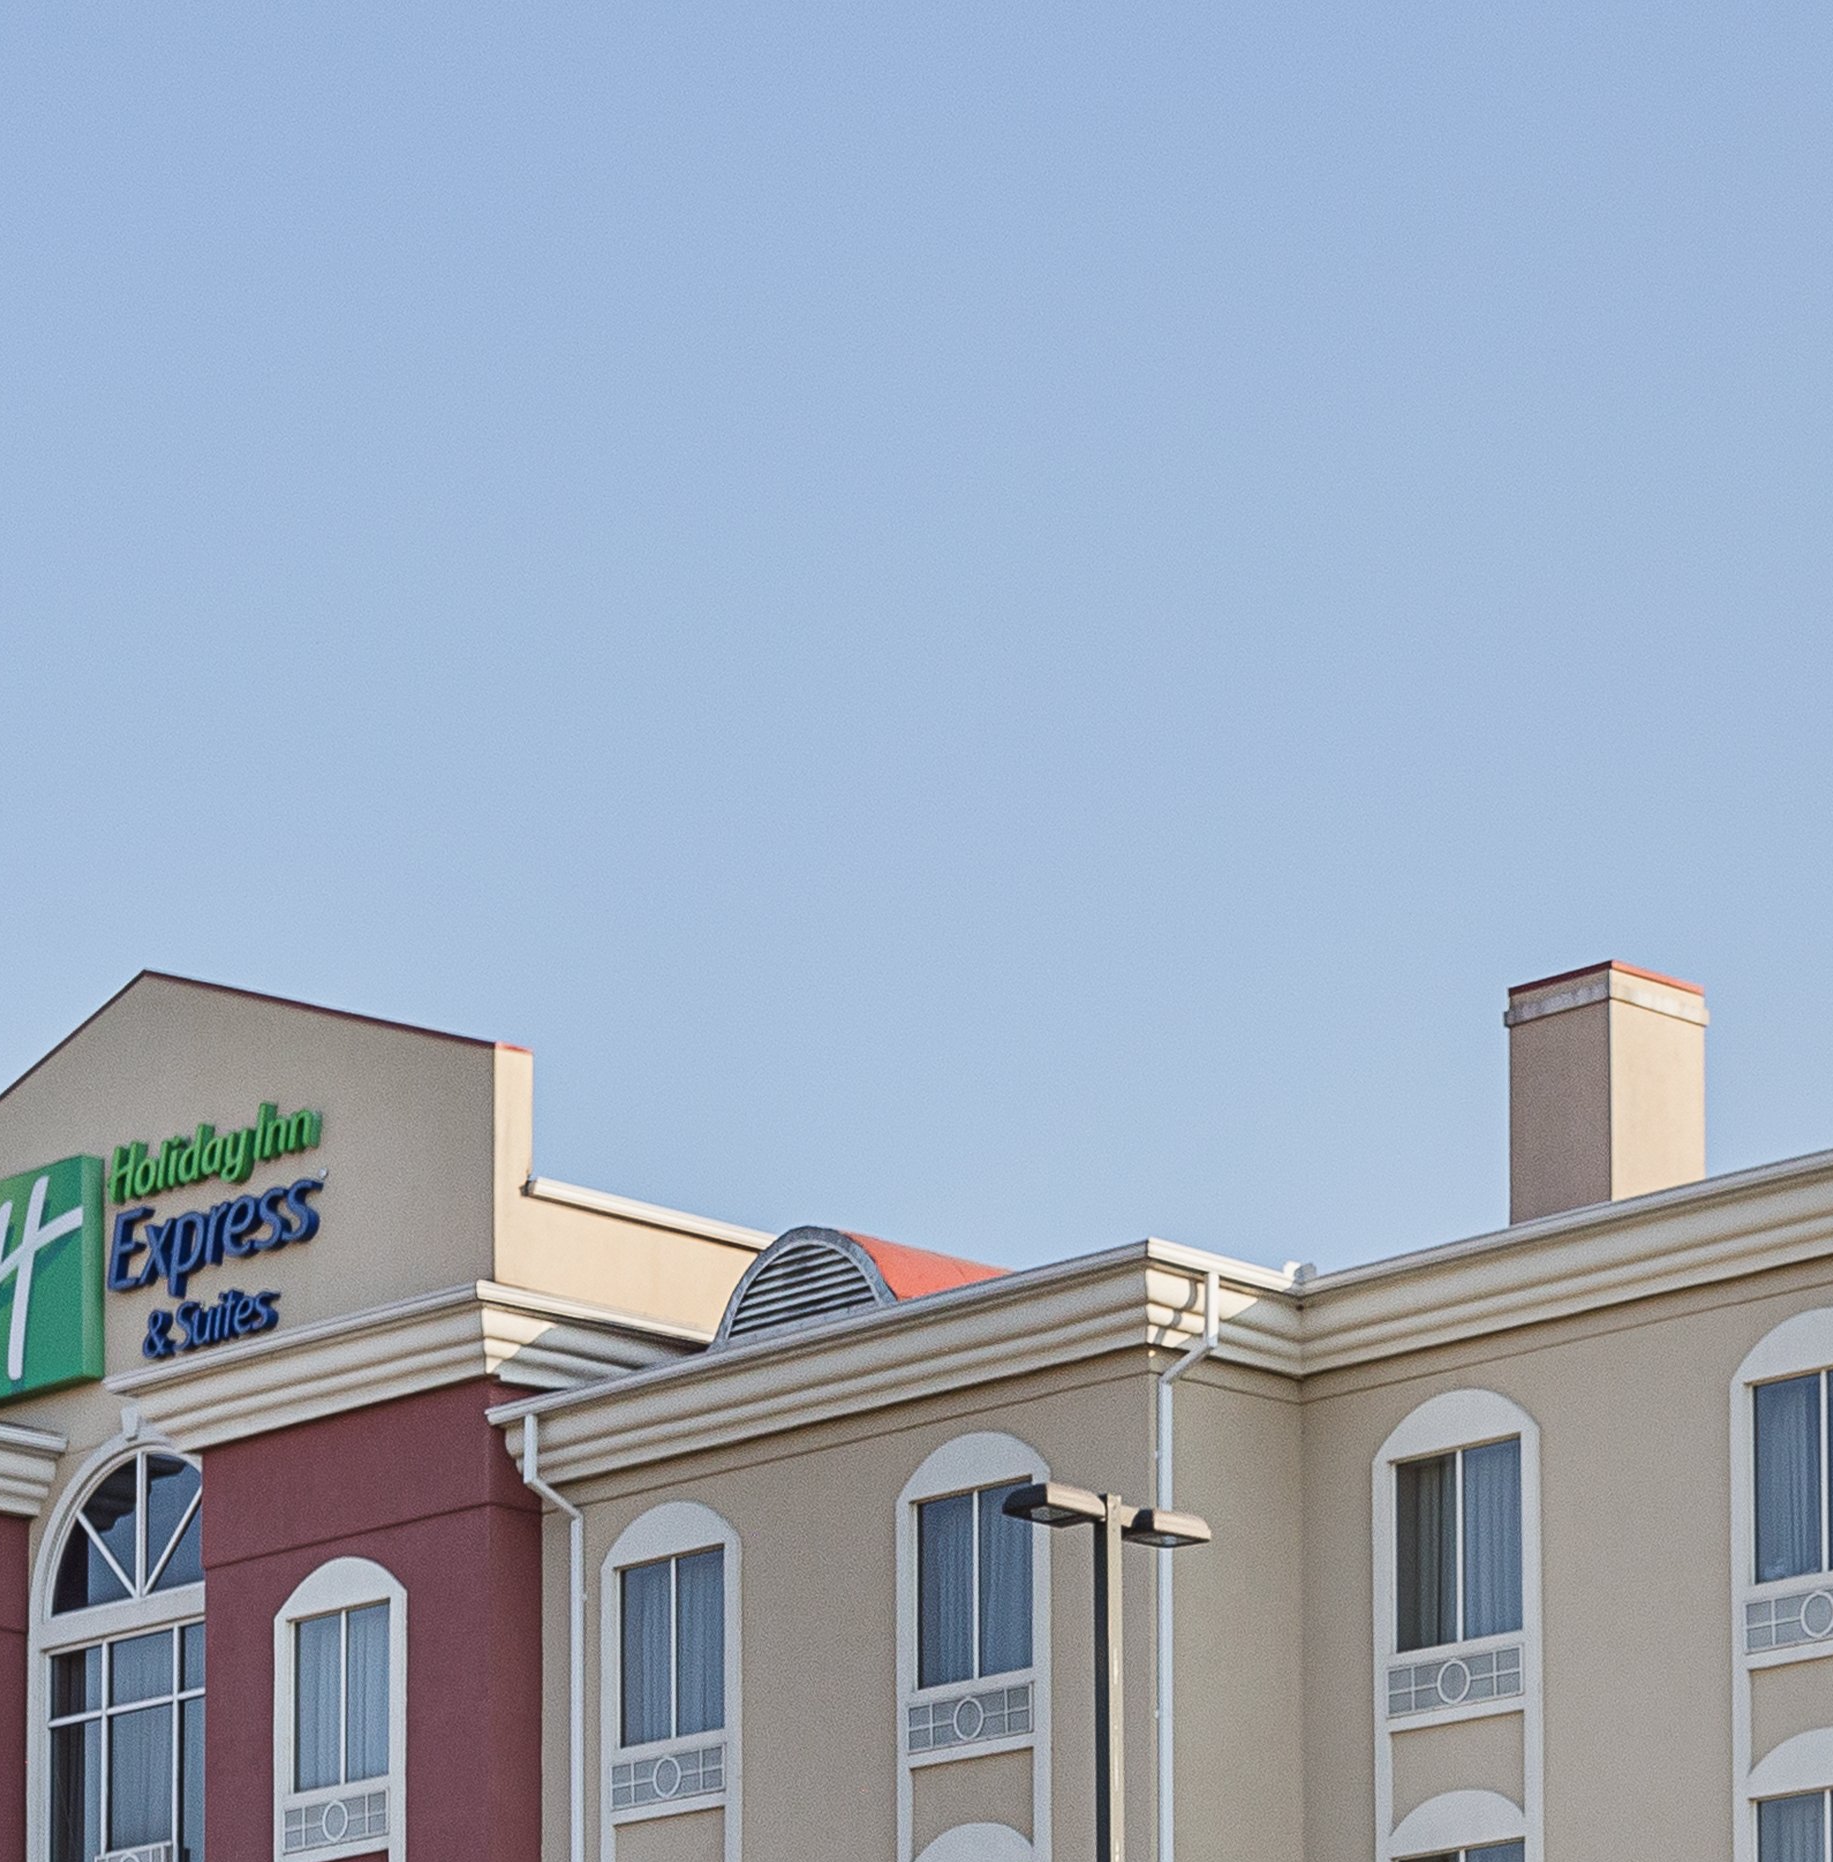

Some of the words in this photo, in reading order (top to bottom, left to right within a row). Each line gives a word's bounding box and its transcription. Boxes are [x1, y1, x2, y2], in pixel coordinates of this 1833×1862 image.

[107, 1122, 256, 1205] Holiday
[253, 1100, 323, 1161] Inn
[107, 1180, 325, 1299] Express
[142, 1307, 178, 1360] &
[174, 1289, 282, 1348] Suites
